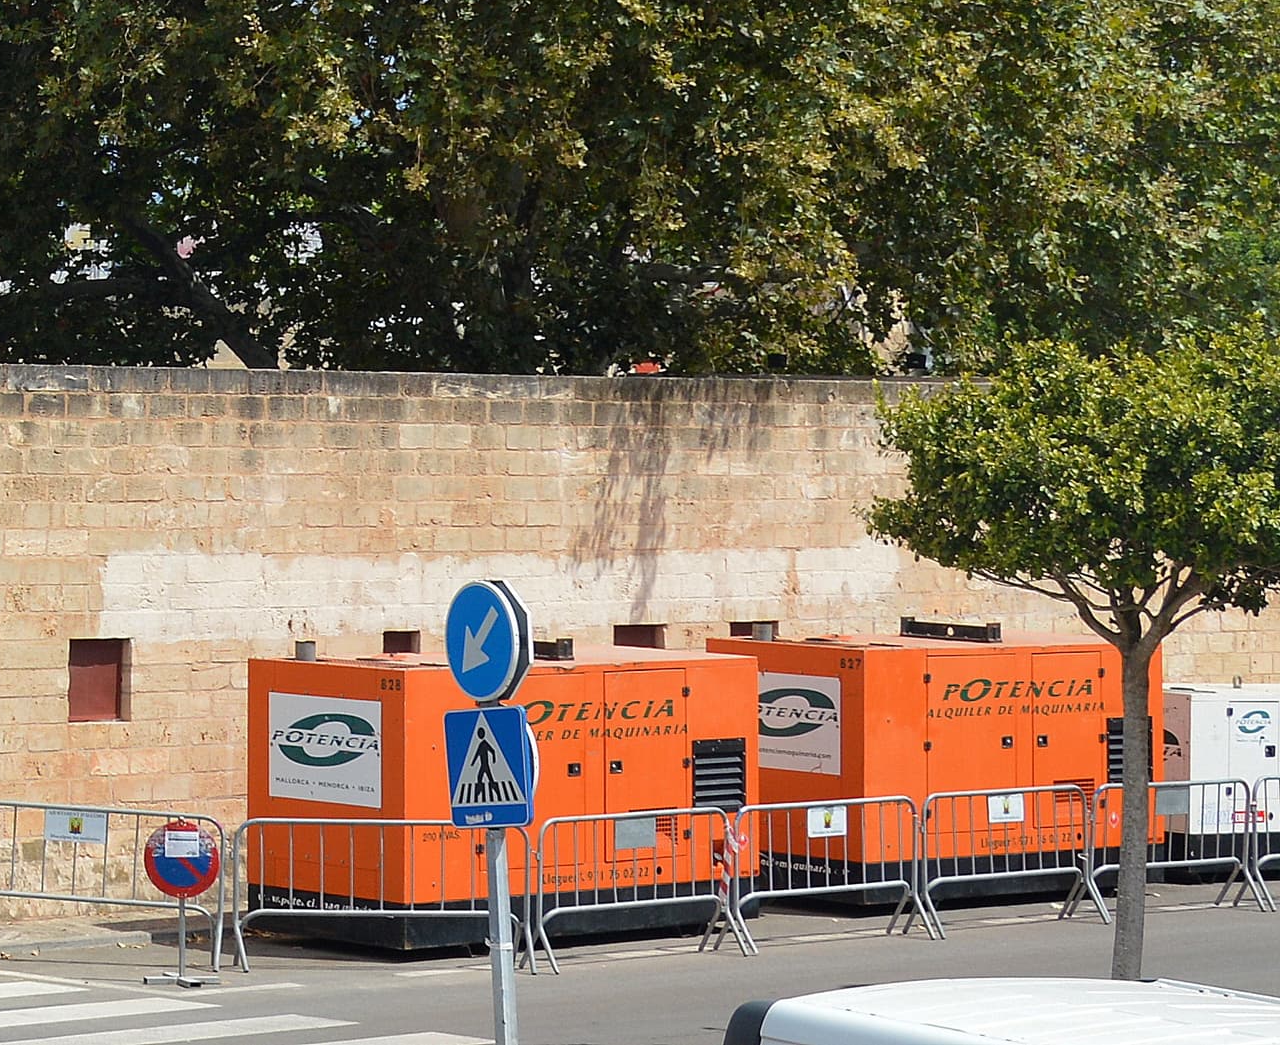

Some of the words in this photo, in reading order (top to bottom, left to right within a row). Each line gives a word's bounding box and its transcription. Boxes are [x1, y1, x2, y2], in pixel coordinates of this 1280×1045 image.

[943, 678, 1093, 702] POTENCIA
[525, 700, 674, 726] OTENCIA
[759, 704, 839, 722] TENCIA
[927, 706, 992, 720] ALQUILER
[998, 705, 1013, 716] DE
[1021, 701, 1105, 717] MAQUINARIA
[271, 730, 380, 751] POTENCIA
[561, 729, 580, 740] DE
[590, 723, 688, 740] MAQUINARIA
[275, 776, 309, 786] MALLORCA
[318, 781, 349, 790] MENORCA
[357, 785, 375, 793] IBIZA
